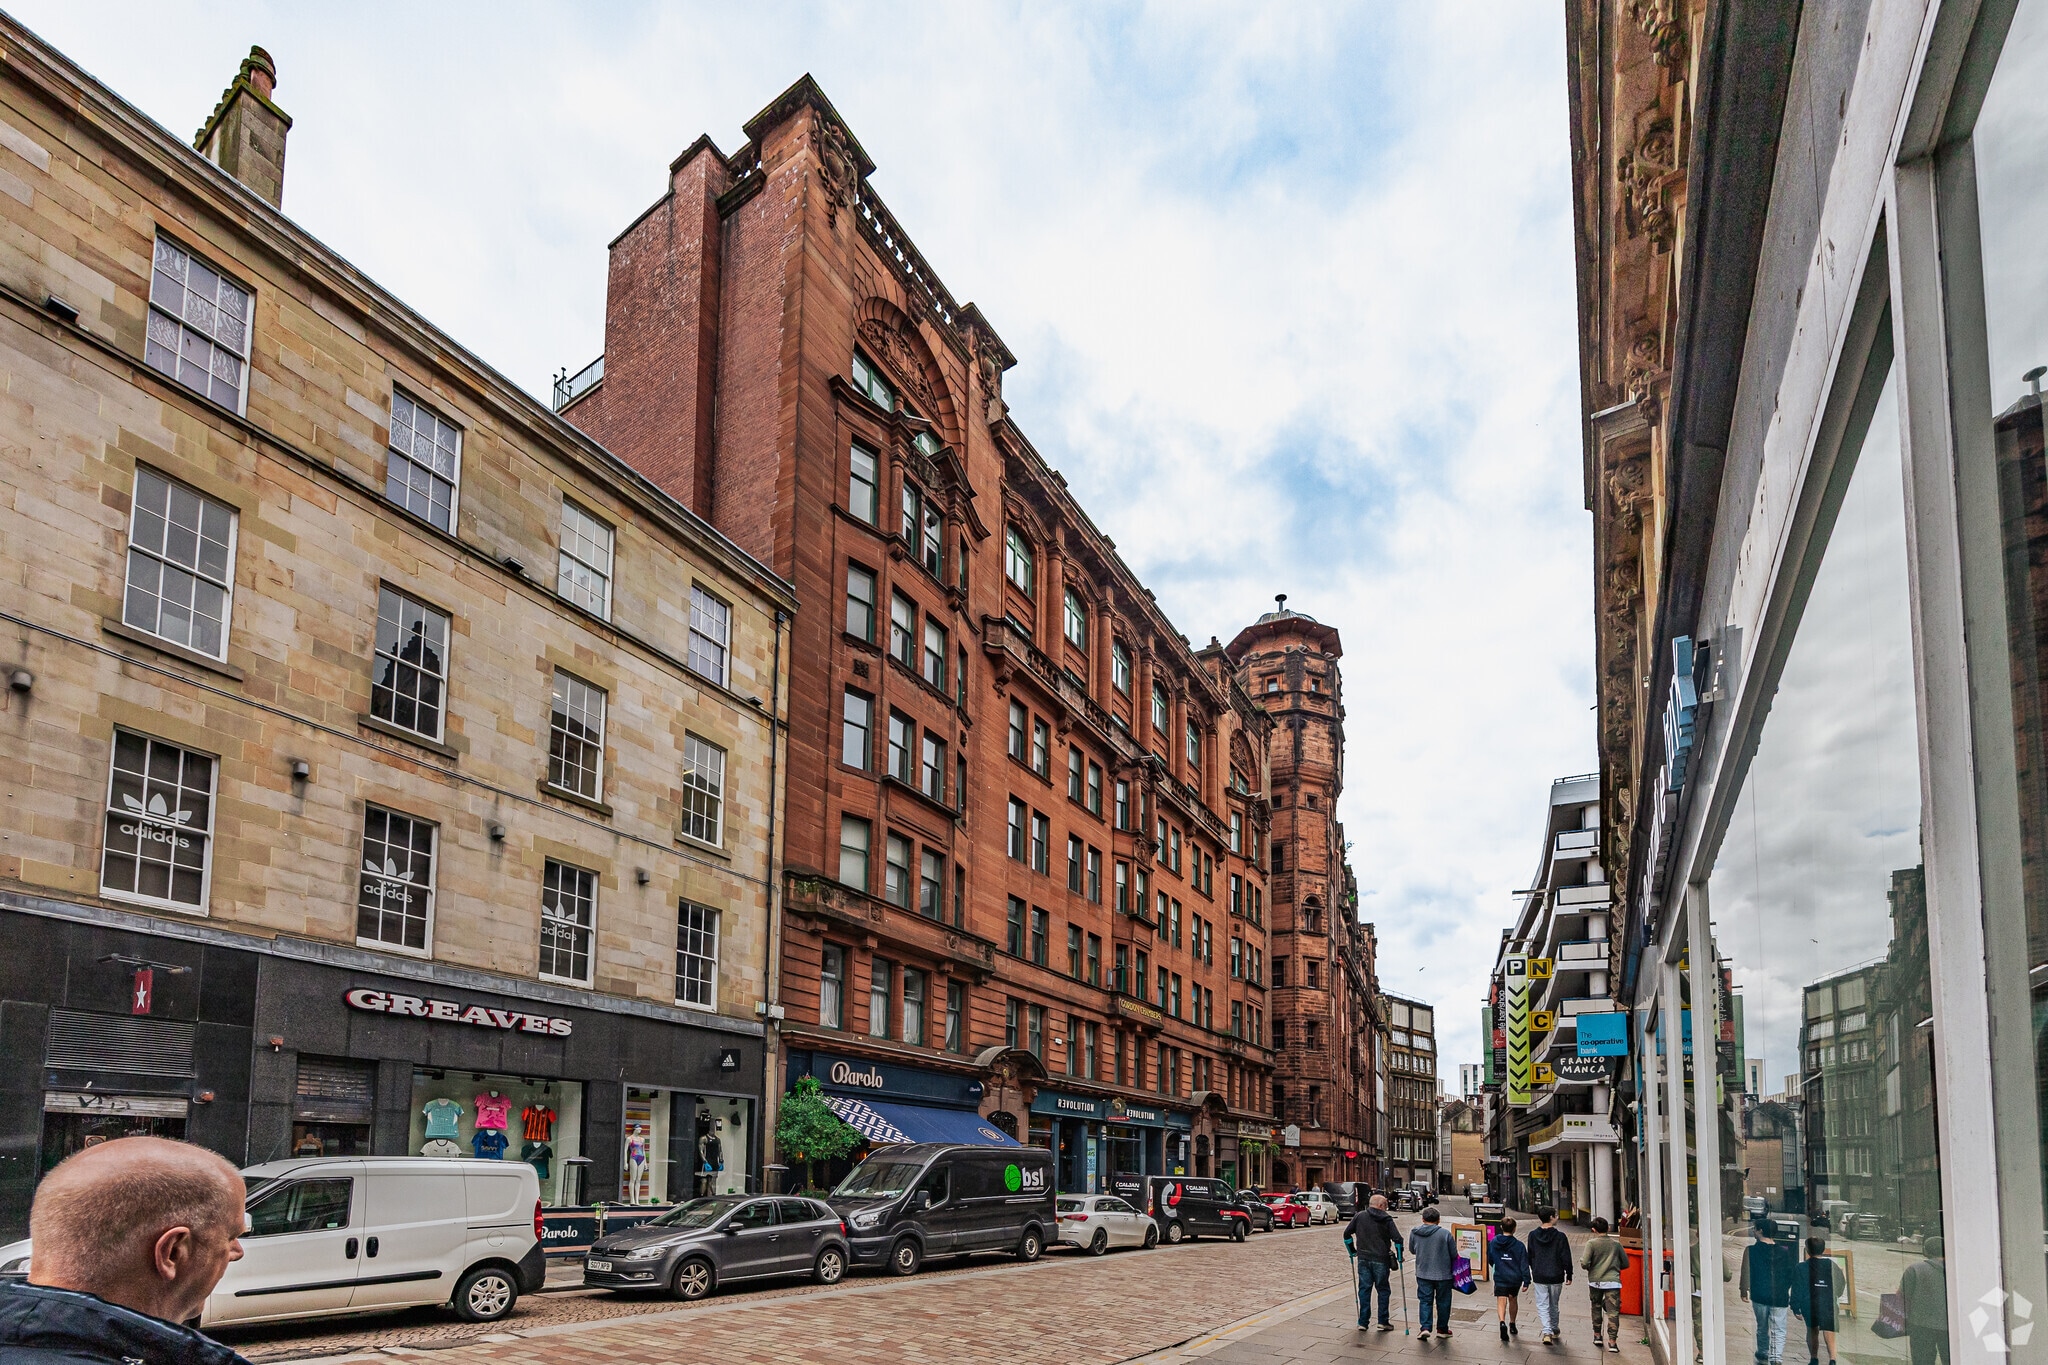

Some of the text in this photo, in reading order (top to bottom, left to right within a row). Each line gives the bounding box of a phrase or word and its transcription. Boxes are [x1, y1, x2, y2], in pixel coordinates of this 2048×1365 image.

[119, 823, 190, 849] adidas
[363, 883, 413, 904] adidas
[541, 926, 577, 941] adidas
[1510, 960, 1523, 974] P
[346, 988, 572, 1036] GREAVES
[1120, 999, 1140, 1013] GORDON
[1580, 1038, 1624, 1046] co-operative
[1580, 1047, 1598, 1055] bank
[1560, 1056, 1605, 1065] FRANCO
[830, 1061, 883, 1088] Barolo
[1561, 1065, 1606, 1074] MANCA
[1057, 1098, 1095, 1112] REVOLUTION
[1126, 1108, 1155, 1121] REVOLUTION
[1535, 1161, 1544, 1171] P
[541, 1225, 578, 1239] Barolo
